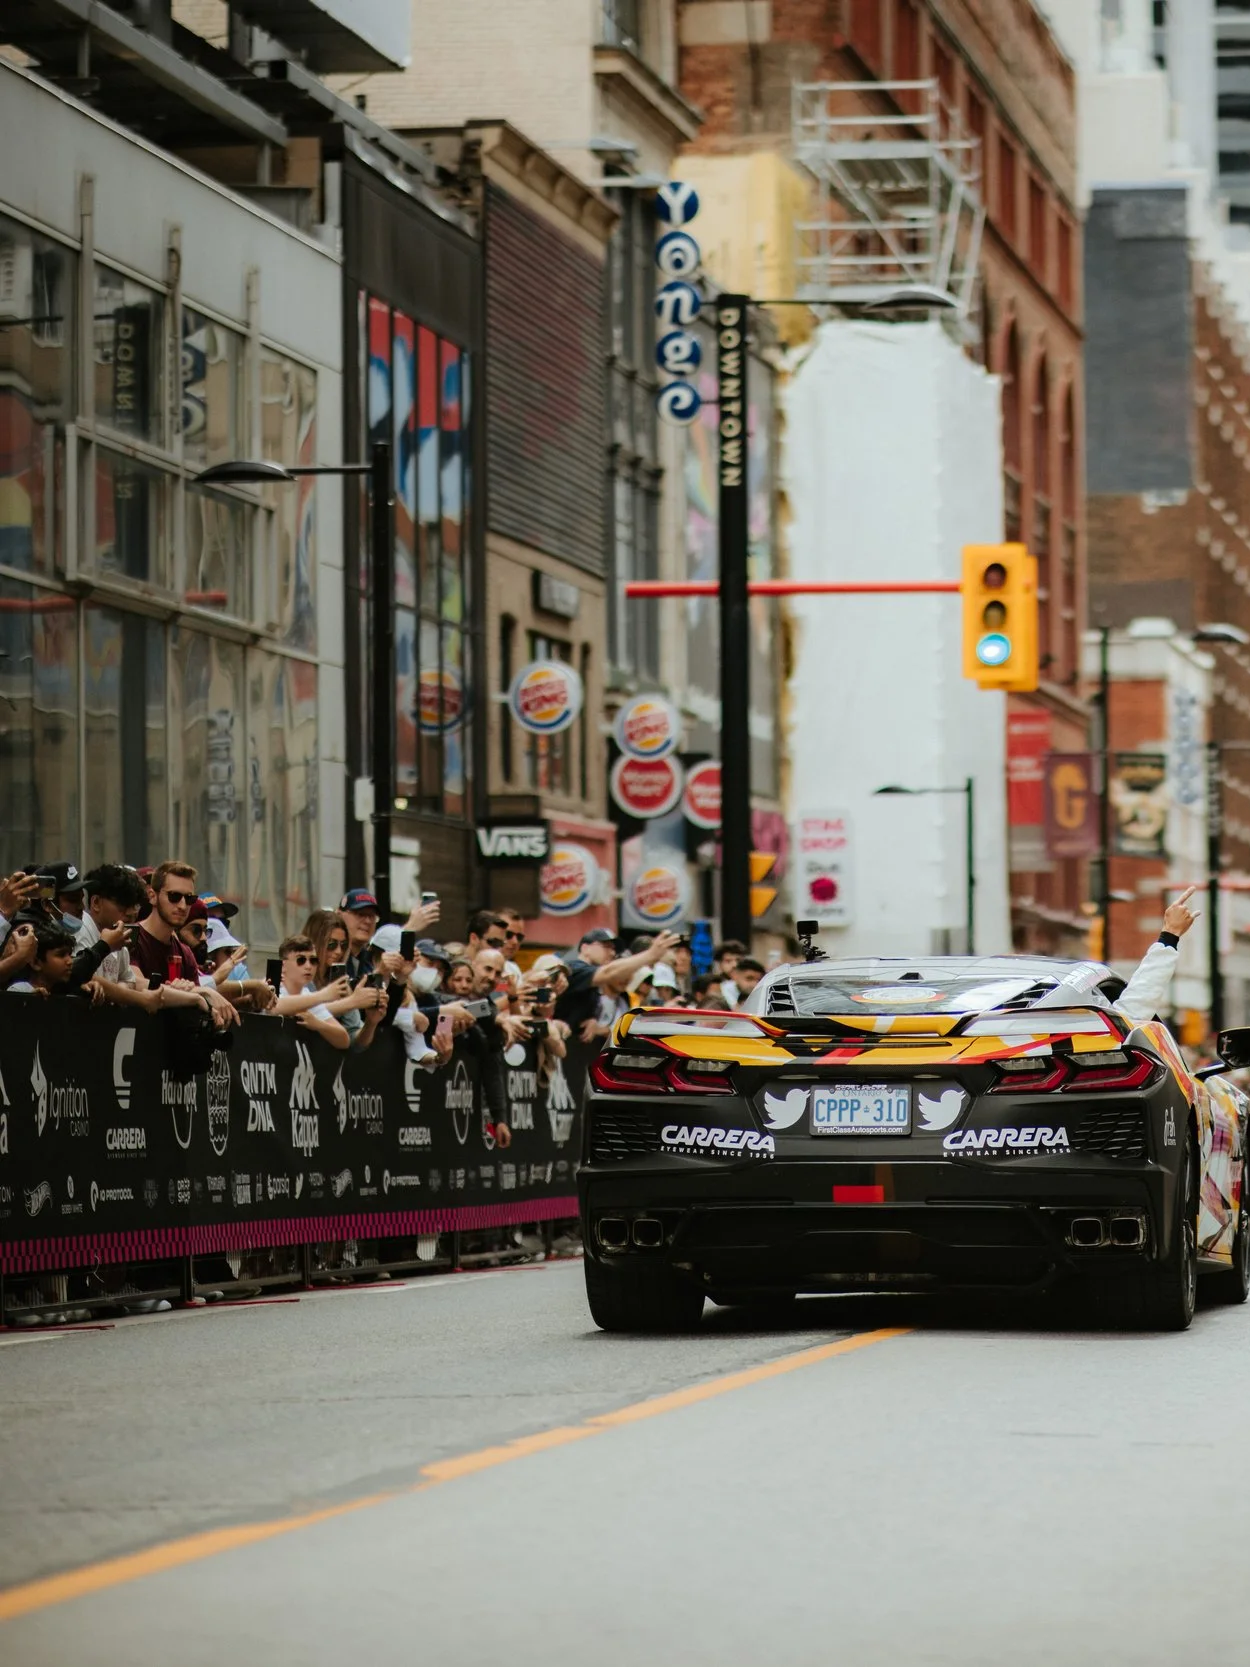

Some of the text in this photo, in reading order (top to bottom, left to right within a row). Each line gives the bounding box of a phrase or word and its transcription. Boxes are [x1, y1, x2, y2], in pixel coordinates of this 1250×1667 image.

[655, 182, 701, 426] Yonge
[719, 307, 743, 487] DOWNTOWN
[477, 827, 548, 858] VANS
[240, 1060, 277, 1098] QNTM
[50, 1077, 89, 1131] Ignition
[247, 1100, 275, 1132] DNA
[348, 1087, 383, 1129] Ignition
[106, 1127, 147, 1150] CARRERA
[291, 1109, 320, 1158] Kappa
[398, 1127, 432, 1145] CARRERA
[661, 1125, 775, 1152] CARRERA
[817, 1126, 903, 1134] FirstClassAutosports.com
[942, 1126, 1070, 1150] CARRERA
[660, 1145, 776, 1160] EYEWEAR SINCE 1956
[943, 1149, 998, 1158] EYEWEAR
[106, 1188, 134, 1200] PROTOCOL
